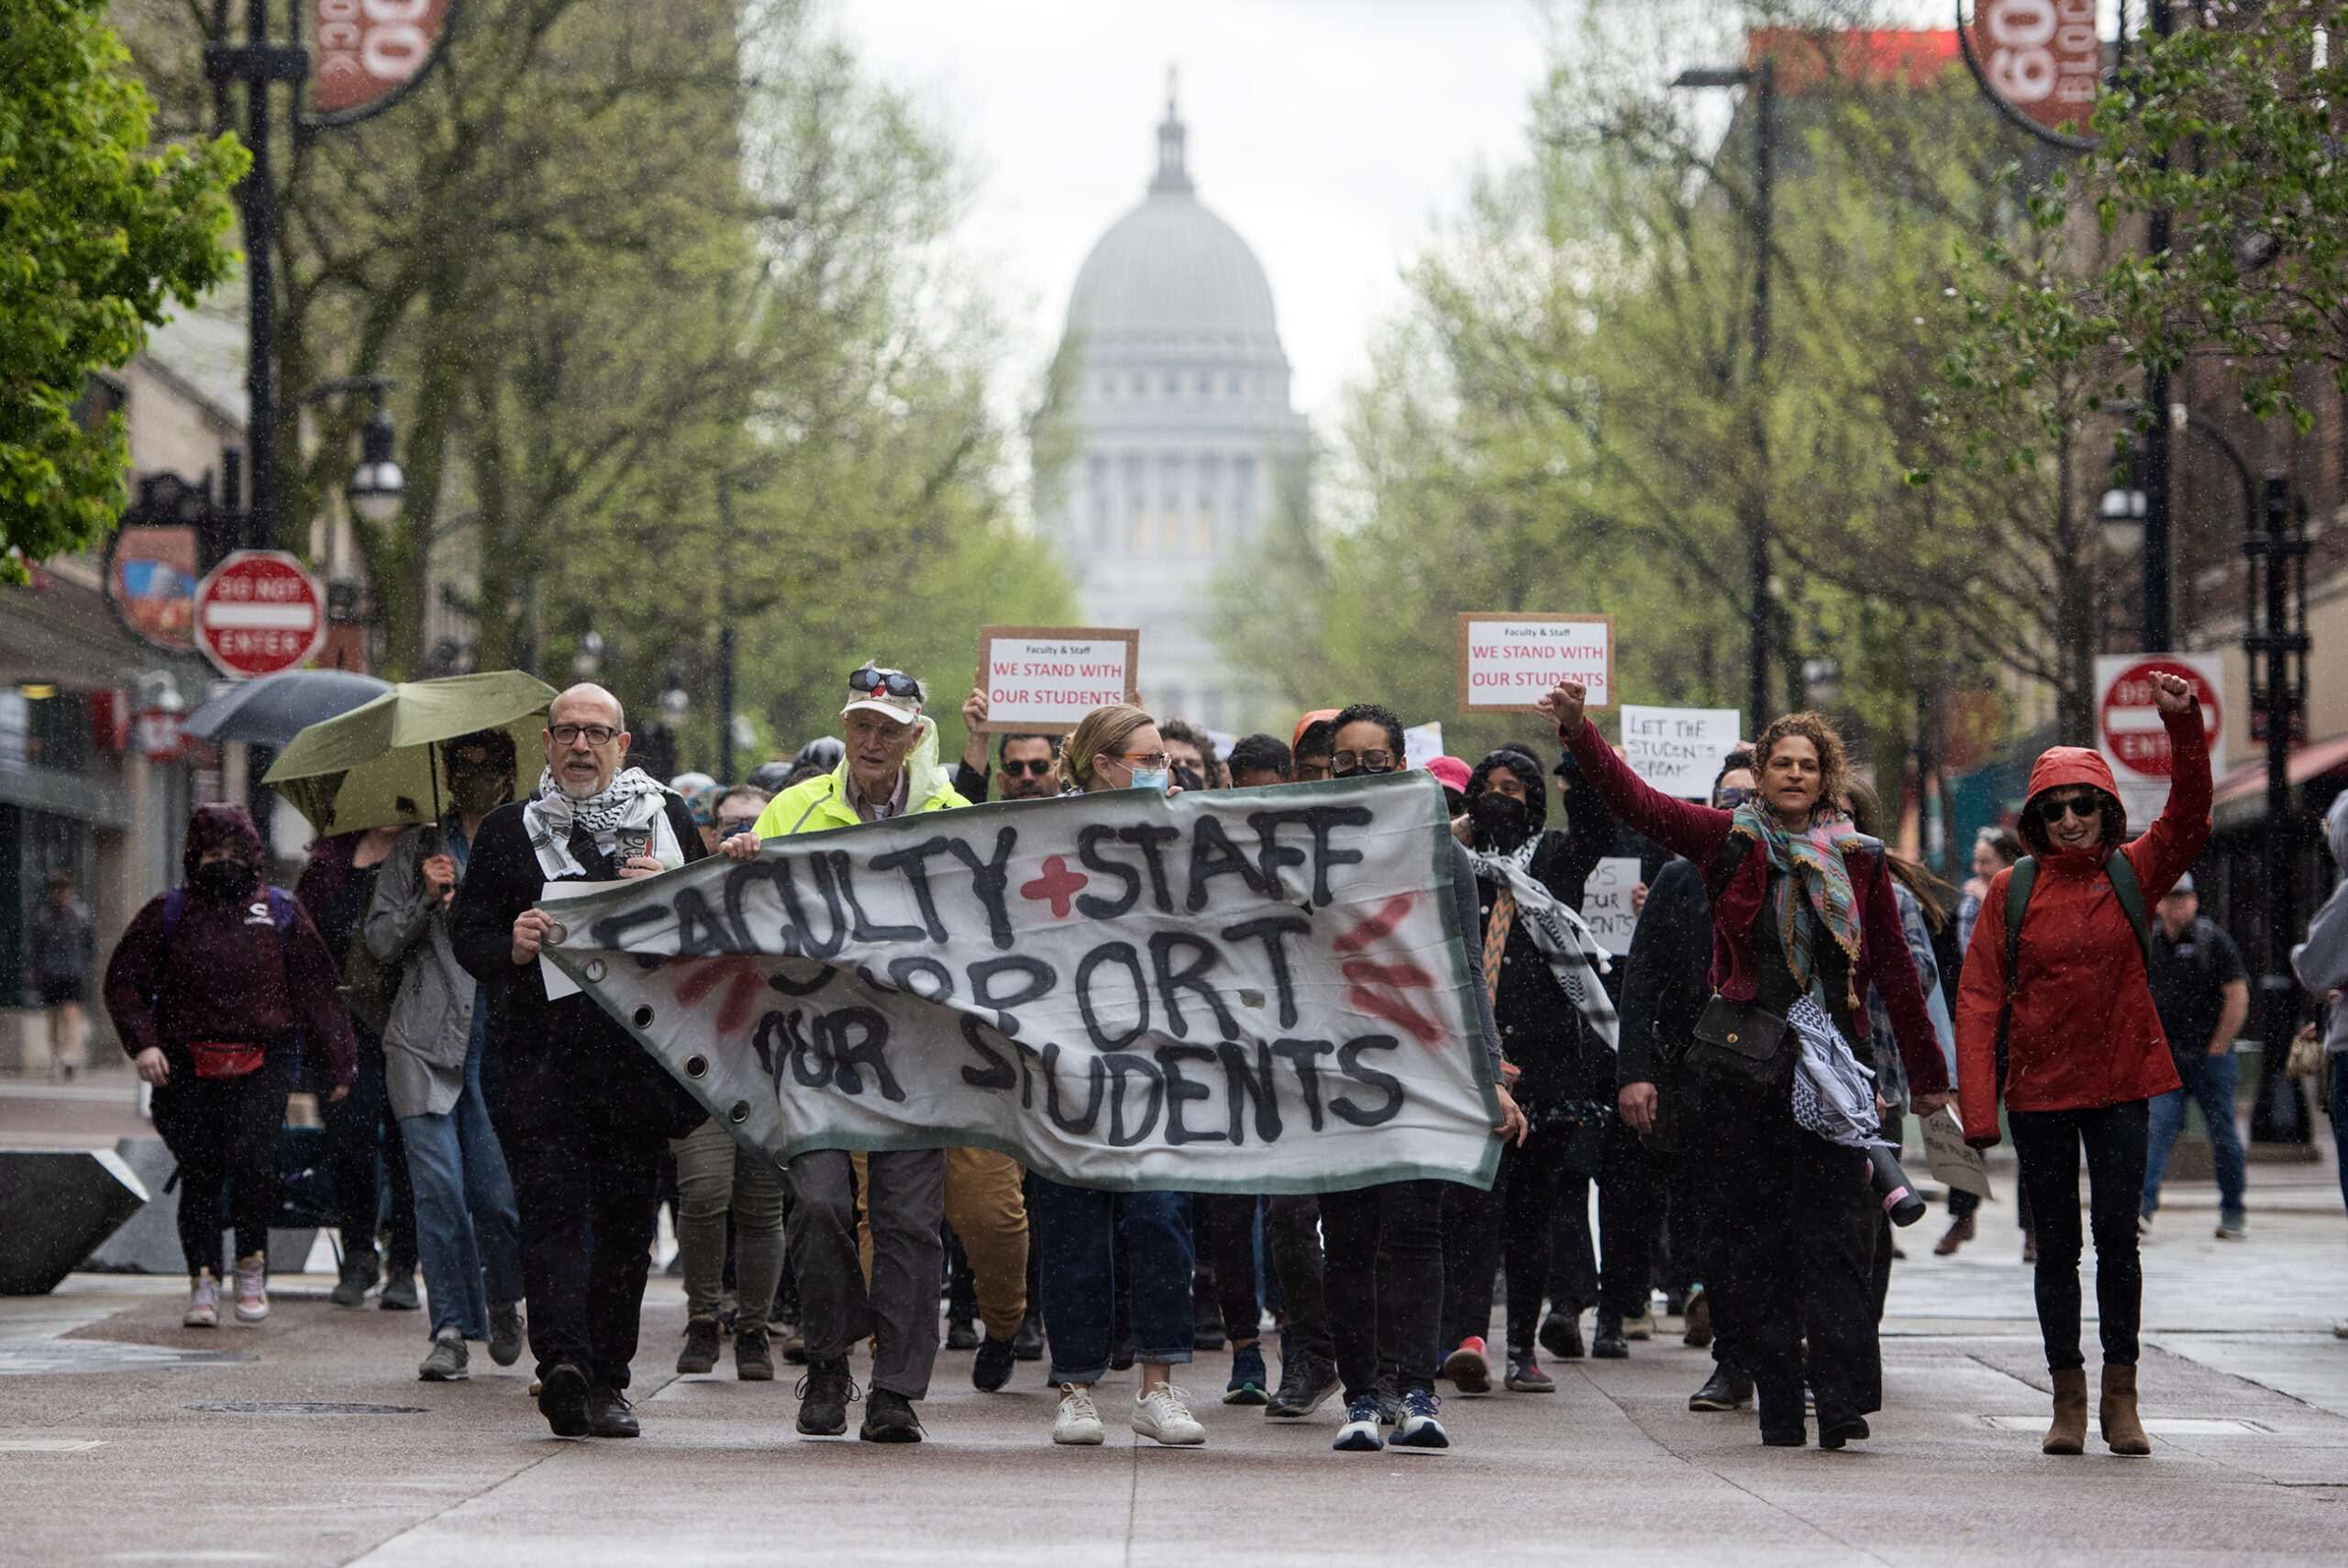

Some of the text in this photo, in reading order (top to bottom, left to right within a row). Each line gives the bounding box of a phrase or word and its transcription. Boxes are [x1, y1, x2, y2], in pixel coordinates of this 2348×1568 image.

[217, 576, 301, 602] DO NOT
[1505, 628, 1570, 637] Faculty & Staff
[218, 630, 301, 657] ENTER
[1026, 646, 1091, 656] Faculty & Staff
[1472, 646, 1603, 658] WE STAND WITH
[993, 662, 1122, 678] WE STAND WITH
[1472, 672, 1510, 686] OUR
[991, 689, 1121, 705] OUR STUDENTS
[1631, 714, 1707, 737] LET THE
[1629, 739, 1716, 759] STUDENTS
[1633, 760, 1690, 778] SPEAK
[1076, 806, 1374, 920] STAFF
[752, 1006, 1404, 1147] OUR STUDENTS
